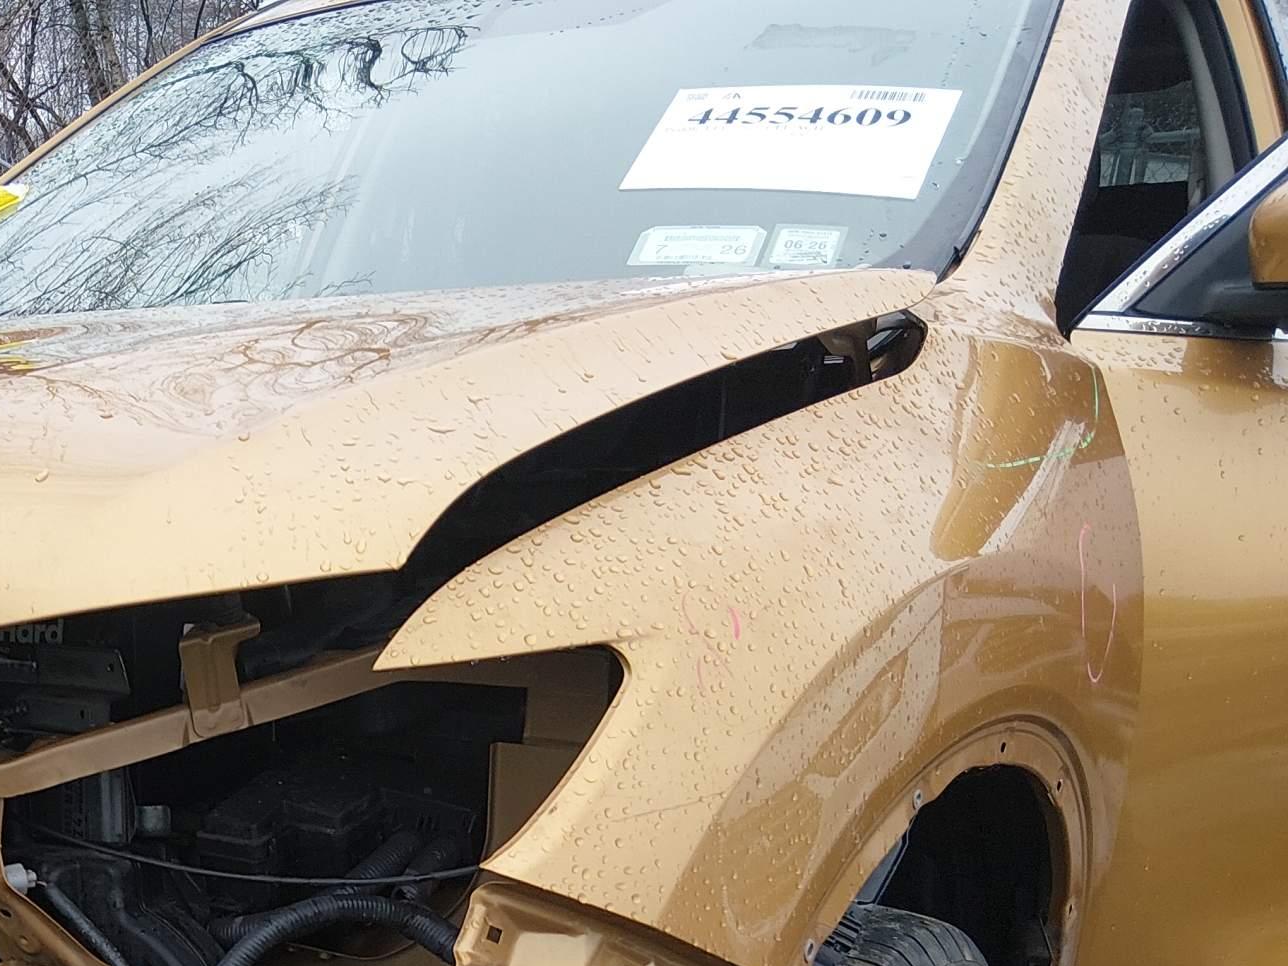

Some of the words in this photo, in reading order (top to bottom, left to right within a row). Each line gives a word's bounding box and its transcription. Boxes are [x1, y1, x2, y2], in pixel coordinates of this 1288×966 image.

[687, 106, 913, 126] 44554609
[720, 244, 747, 256] 26
[783, 239, 803, 249] 06
